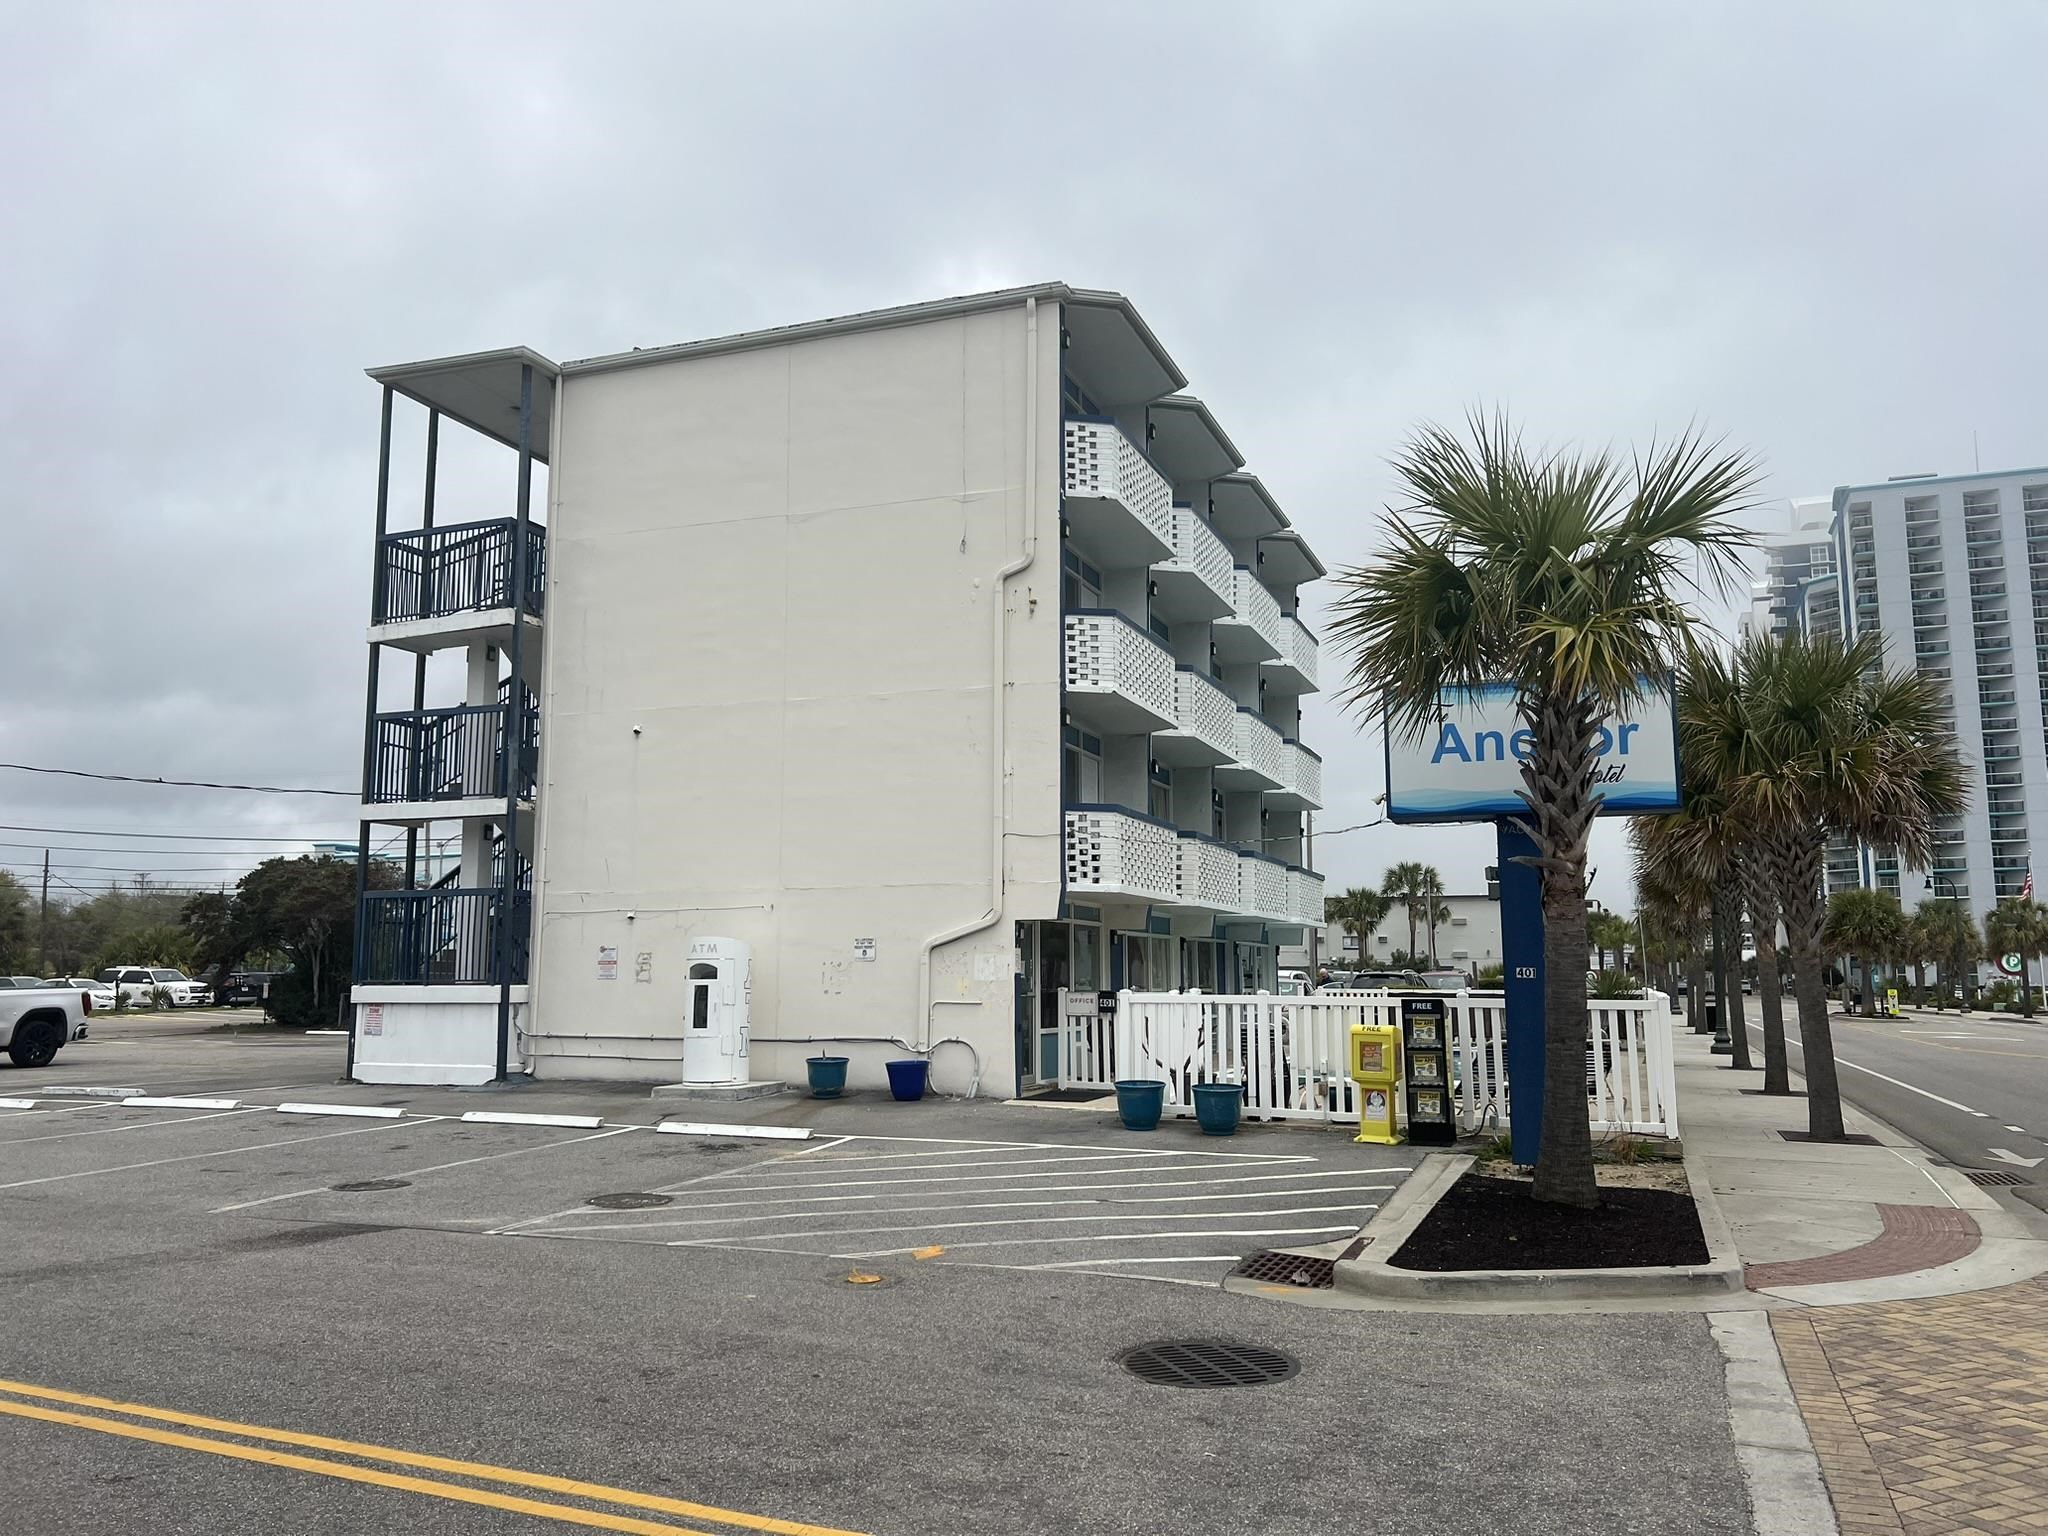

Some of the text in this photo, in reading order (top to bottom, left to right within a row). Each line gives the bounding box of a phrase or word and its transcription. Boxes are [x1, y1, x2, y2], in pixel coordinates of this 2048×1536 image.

[1430, 722, 1640, 764] Ancor
[691, 943, 718, 954] ATM
[1516, 967, 1537, 979] 401
[1100, 999, 1116, 1008] 401
[1412, 1002, 1433, 1010] FREE
